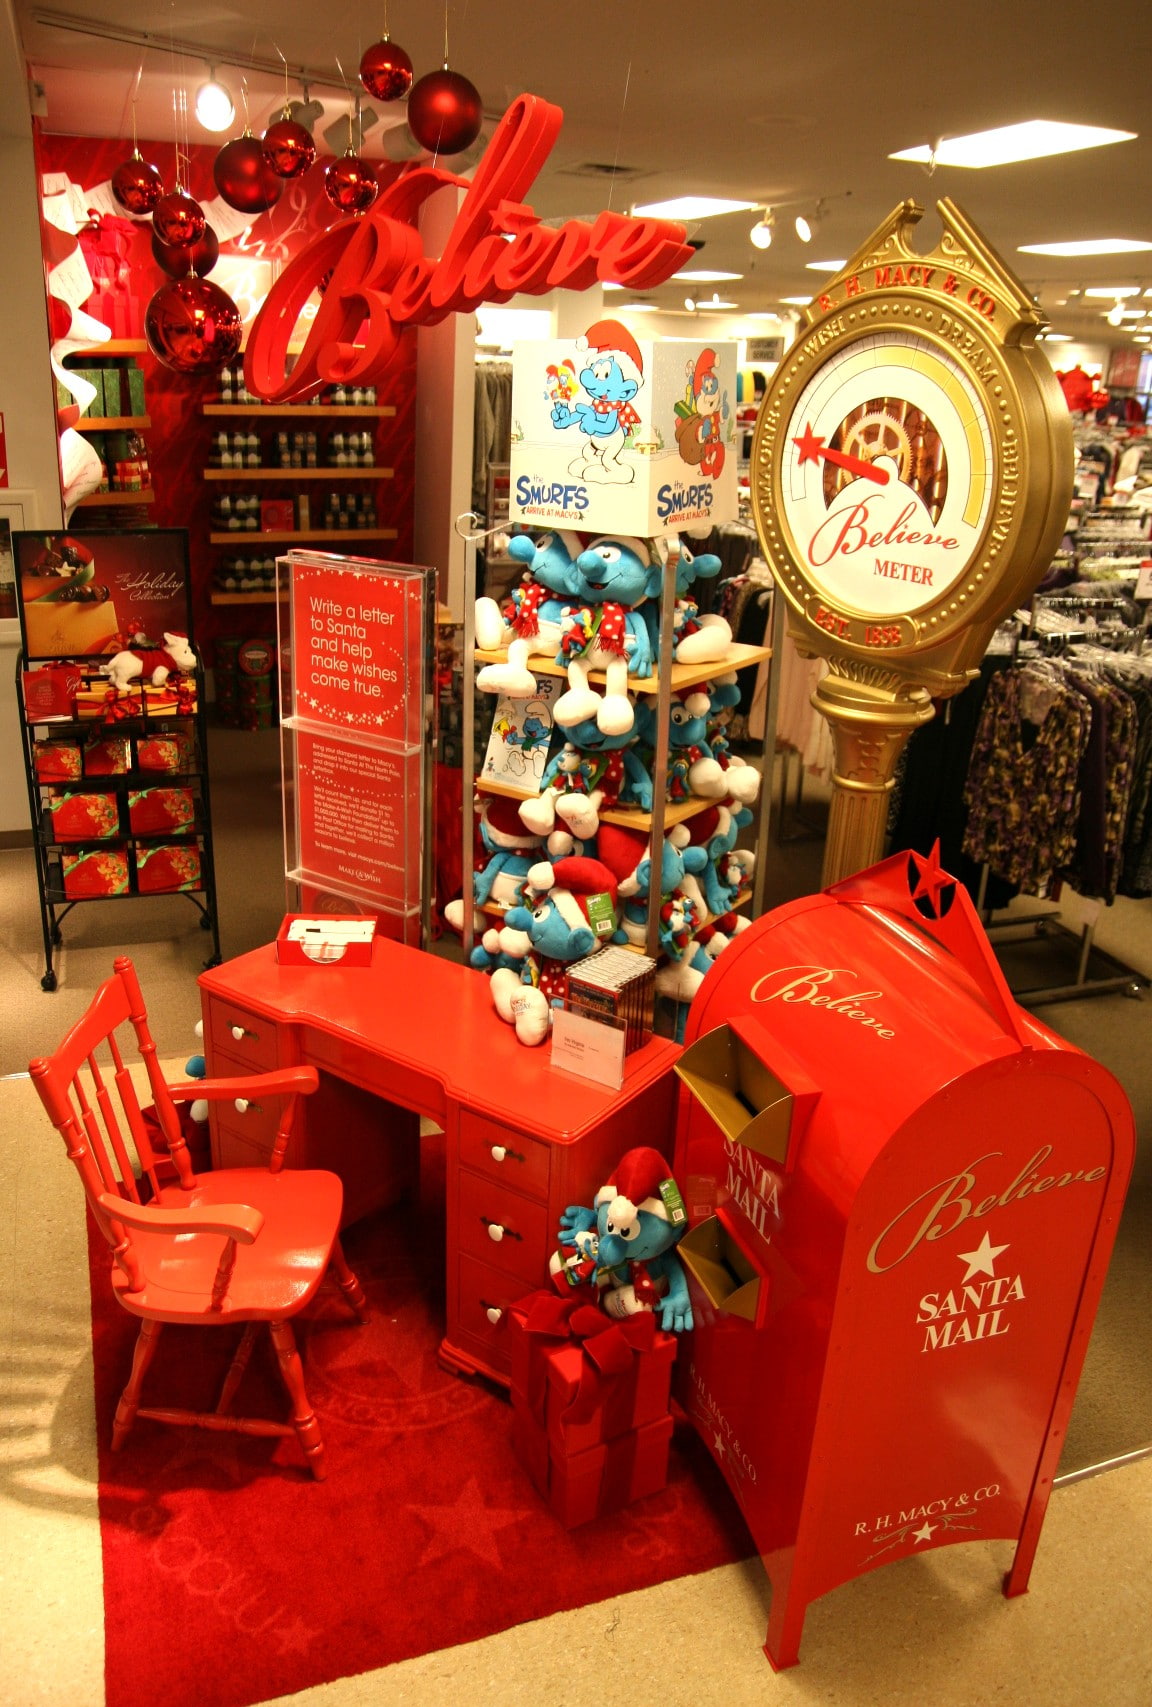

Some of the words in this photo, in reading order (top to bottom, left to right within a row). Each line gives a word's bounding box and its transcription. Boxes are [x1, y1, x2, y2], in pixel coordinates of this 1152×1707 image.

[243, 92, 696, 404] Believe
[874, 266, 936, 290] MACY
[942, 274, 960, 297] &
[937, 312, 999, 387] DREAM
[516, 475, 590, 510] SMURFS
[657, 483, 714, 518] SMURFS
[526, 506, 546, 516] ARRIVE
[546, 508, 554, 517] AT
[668, 514, 685, 524] ARRIVE
[808, 494, 960, 567] Believe
[120, 571, 185, 596] Holiday
[874, 558, 934, 586] METER
[130, 590, 170, 602] Collection
[310, 596, 343, 617] Write
[346, 606, 356, 619] a
[360, 606, 395, 626] letter
[310, 615, 324, 632] to
[327, 618, 366, 640] Santa
[864, 624, 902, 646] 1858
[310, 636, 338, 652] and
[342, 639, 372, 661] help
[310, 672, 350, 690] come
[354, 678, 384, 698] true.
[311, 654, 348, 672] make
[352, 661, 398, 683] wishes
[750, 965, 896, 1041] Believe
[724, 1138, 780, 1220] SANTA
[725, 1163, 772, 1245] MAIL
[866, 1144, 1106, 1274] Believe
[916, 1274, 1026, 1324] SANTA
[920, 1308, 1010, 1353] MAIL
[854, 1522, 872, 1536] R.
[876, 1514, 892, 1530] H.
[898, 1496, 954, 1524] MACY
[954, 1492, 970, 1508] &
[974, 1484, 1001, 1502] CO.
